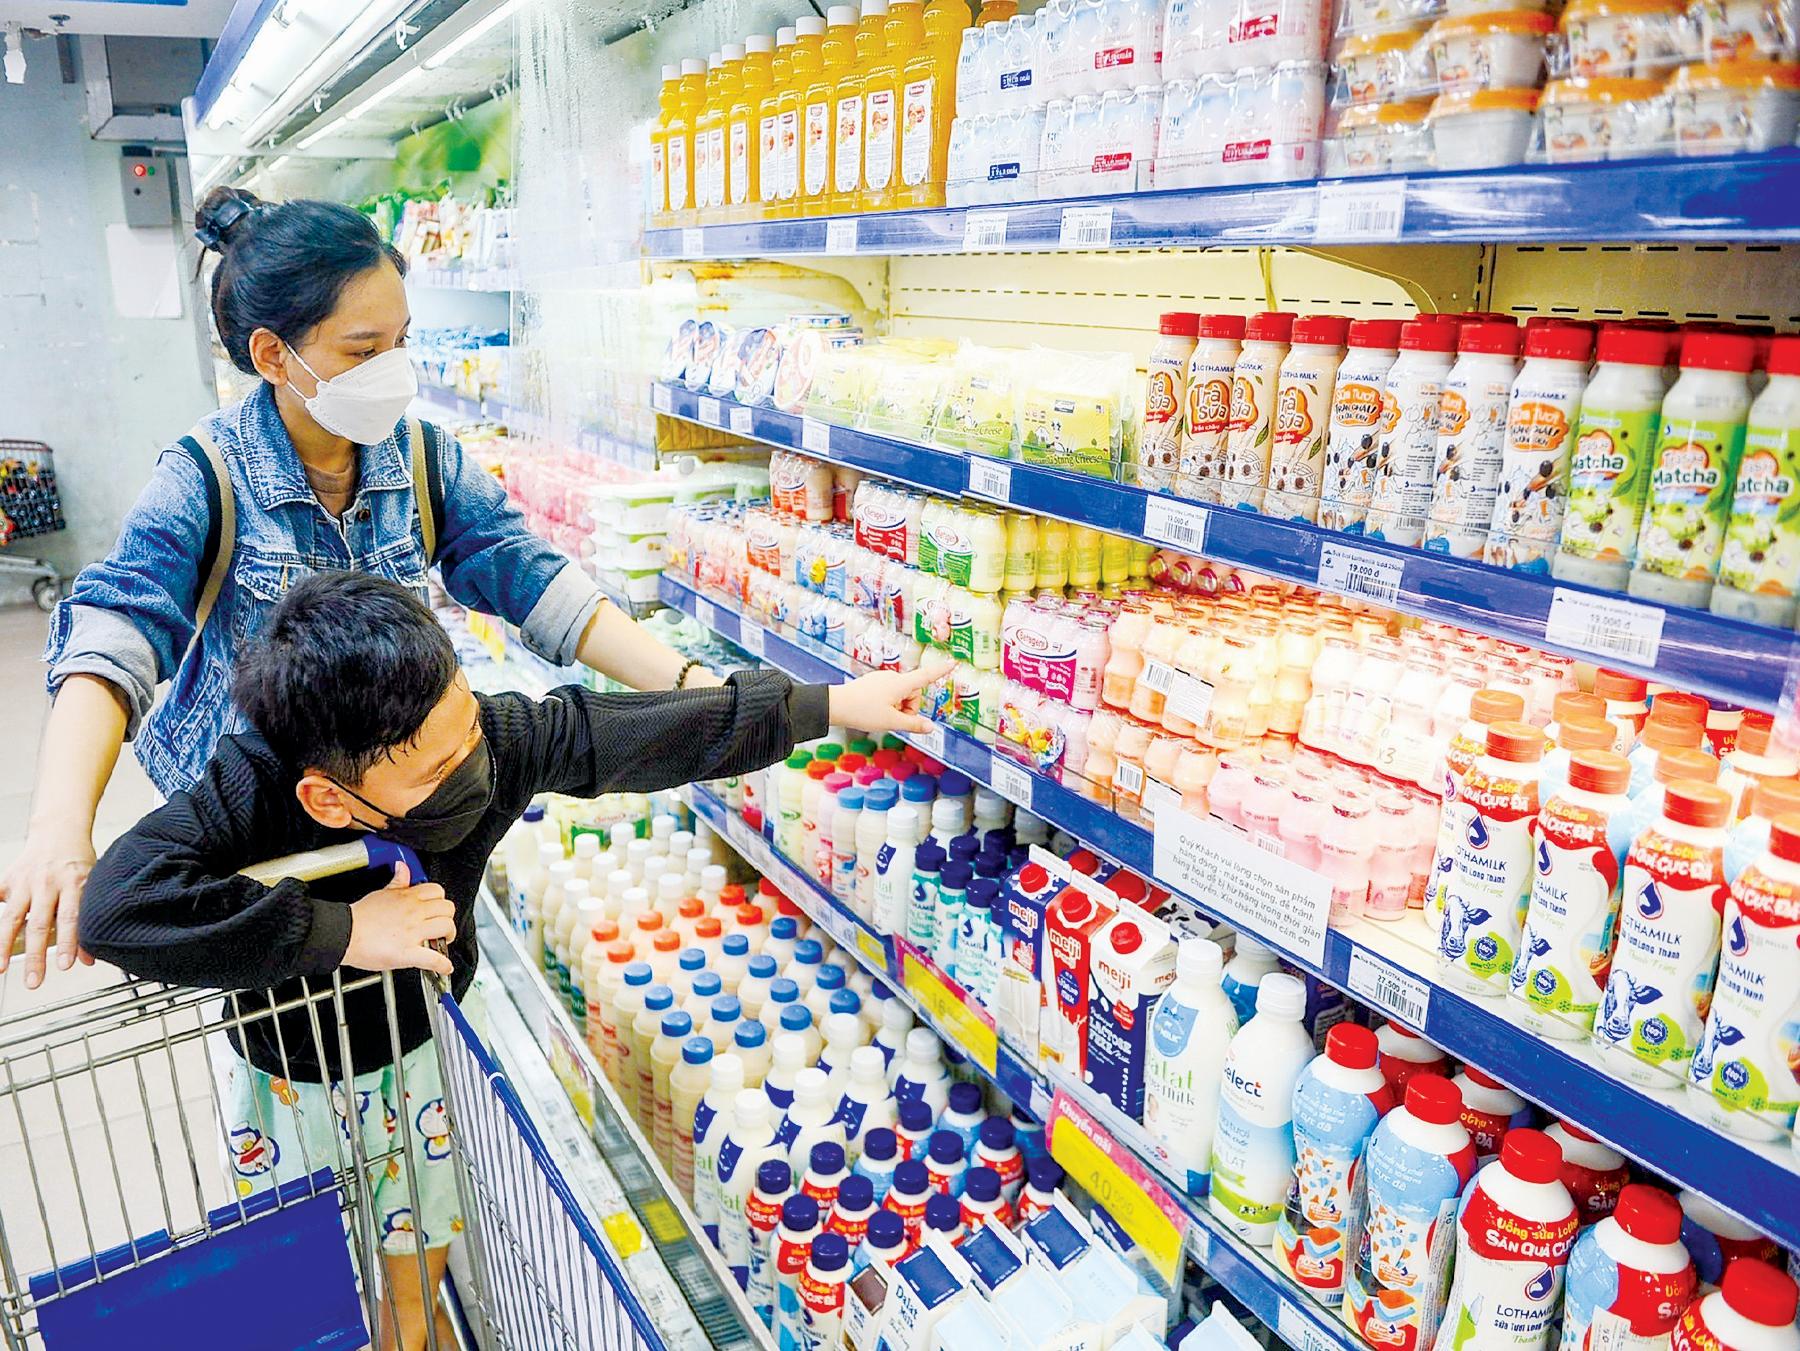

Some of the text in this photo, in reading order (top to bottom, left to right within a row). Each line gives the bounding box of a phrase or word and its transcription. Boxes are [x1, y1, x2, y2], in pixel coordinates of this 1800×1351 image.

[1194, 382, 1222, 408] Trà
[1737, 477, 1790, 494] atcha
[1349, 563, 1373, 576] 19.000
[1221, 857, 1232, 867] vui
[1254, 873, 1272, 888] chọn
[1240, 879, 1254, 891] sau
[1221, 893, 1232, 904] Xin
[1010, 902, 1038, 930] meiji
[1260, 902, 1282, 920] trong
[1303, 925, 1321, 940] gian
[1051, 931, 1080, 959] meiji
[1098, 960, 1132, 990] meiji
[1378, 974, 1400, 993] 27.500
[1225, 1067, 1262, 1098] elect
[1058, 1098, 1092, 1137] Khuyến
[1460, 1114, 1486, 1128] otha
[1497, 1216, 1528, 1240] Uống
